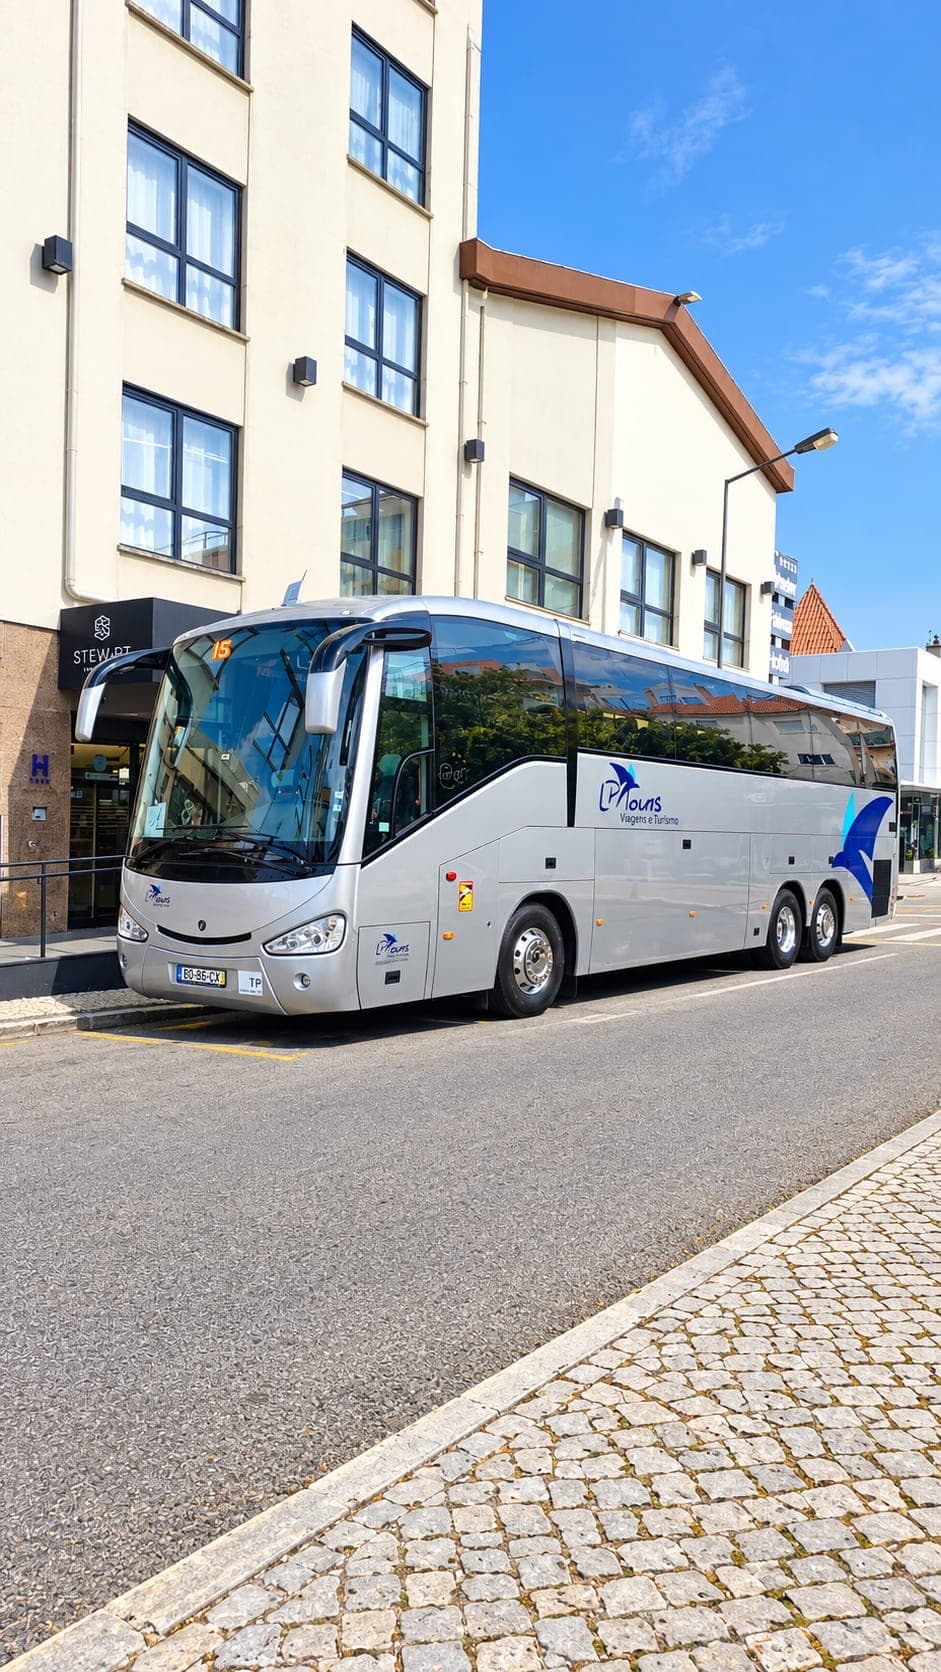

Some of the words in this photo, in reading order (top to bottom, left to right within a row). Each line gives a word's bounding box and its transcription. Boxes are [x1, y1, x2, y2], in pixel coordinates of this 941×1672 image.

[73, 645, 132, 664] STEWRT
[210, 638, 232, 660] 15
[620, 813, 647, 826] Viagens
[648, 816, 653, 825] e
[654, 814, 680, 826] Turismo
[249, 977, 262, 988] TP
